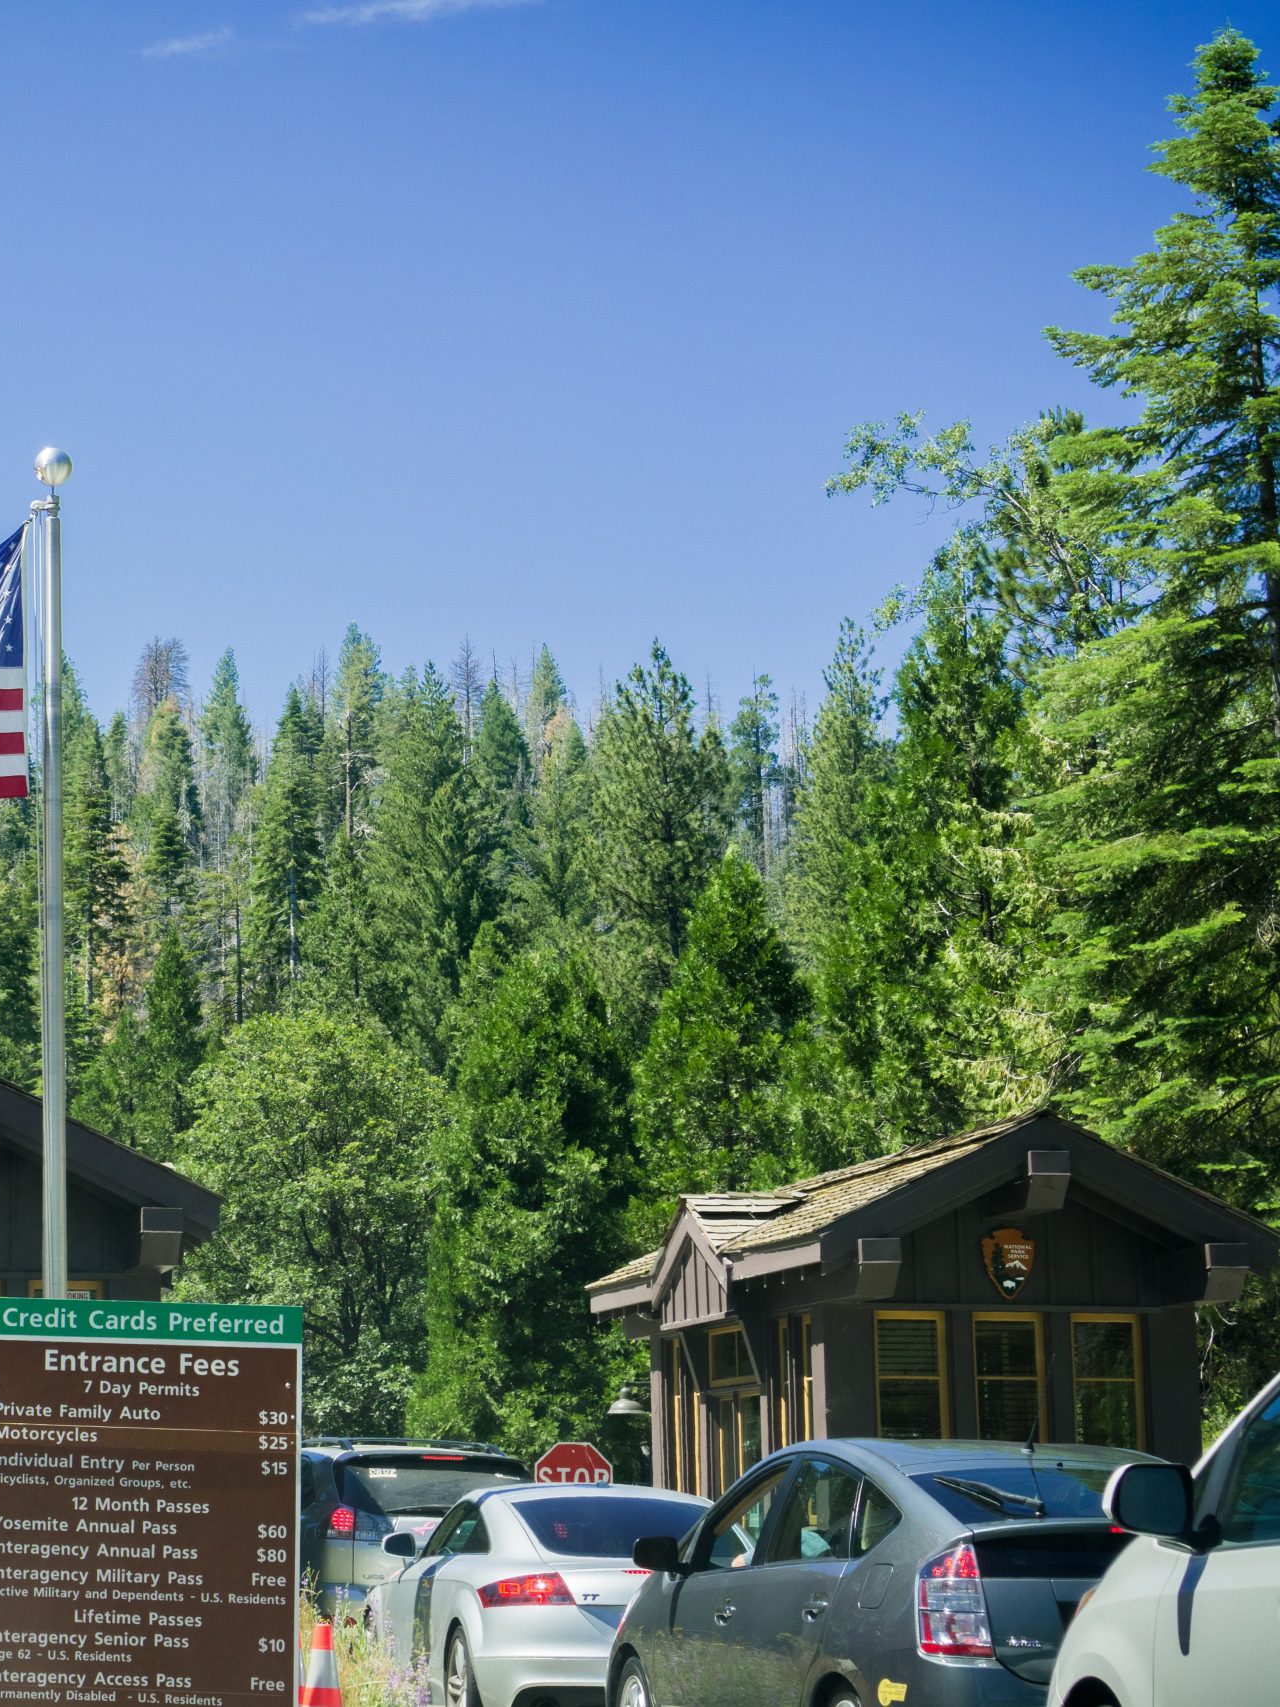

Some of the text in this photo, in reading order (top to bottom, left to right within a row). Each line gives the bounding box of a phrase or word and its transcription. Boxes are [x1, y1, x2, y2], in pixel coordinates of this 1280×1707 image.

[2, 1307, 284, 1335] Credit Cards Preferred
[44, 1349, 240, 1377] Entrance Fees
[83, 1379, 200, 1398] 7 Day Permits
[59, 1404, 112, 1423] Family
[119, 1406, 161, 1421] Auto
[258, 1409, 288, 1426] $30
[258, 1434, 288, 1451] $25
[80, 1455, 125, 1474] Entry
[132, 1460, 151, 1471] Per
[155, 1460, 195, 1472] Person
[261, 1460, 288, 1476] $15
[54, 1475, 115, 1489] Organized
[119, 1477, 165, 1491] Groups,
[169, 1479, 192, 1489] etc.
[71, 1496, 210, 1514] 12 Month Passes
[75, 1518, 135, 1534] Annual
[142, 1520, 177, 1535] Pass
[257, 1523, 287, 1540] $60
[96, 1543, 156, 1559] Annual
[162, 1545, 198, 1560] Pass
[256, 1547, 287, 1564] $80
[96, 1568, 161, 1588] Military
[167, 1570, 203, 1586] Pass
[251, 1572, 287, 1587] Free
[33, 1586, 80, 1601] Military
[84, 1588, 108, 1600] and
[112, 1589, 184, 1603] Dependents
[200, 1592, 223, 1603] U.S.
[228, 1593, 286, 1606] Residents
[582, 1593, 600, 1601] TT
[74, 1608, 202, 1628] Lifetime Passes
[94, 1631, 147, 1647] Senior
[154, 1633, 189, 1649] Pass
[258, 1637, 286, 1653] $10
[17, 1648, 31, 1660] 62
[47, 1649, 70, 1661] U.S.
[74, 1650, 132, 1663] Residents
[93, 1671, 149, 1687] Access
[156, 1673, 192, 1689] Pass
[250, 1676, 285, 1692] Free
[66, 1689, 116, 1702] Disabled
[137, 1692, 160, 1704] U.S.
[164, 1693, 223, 1707] Residents
